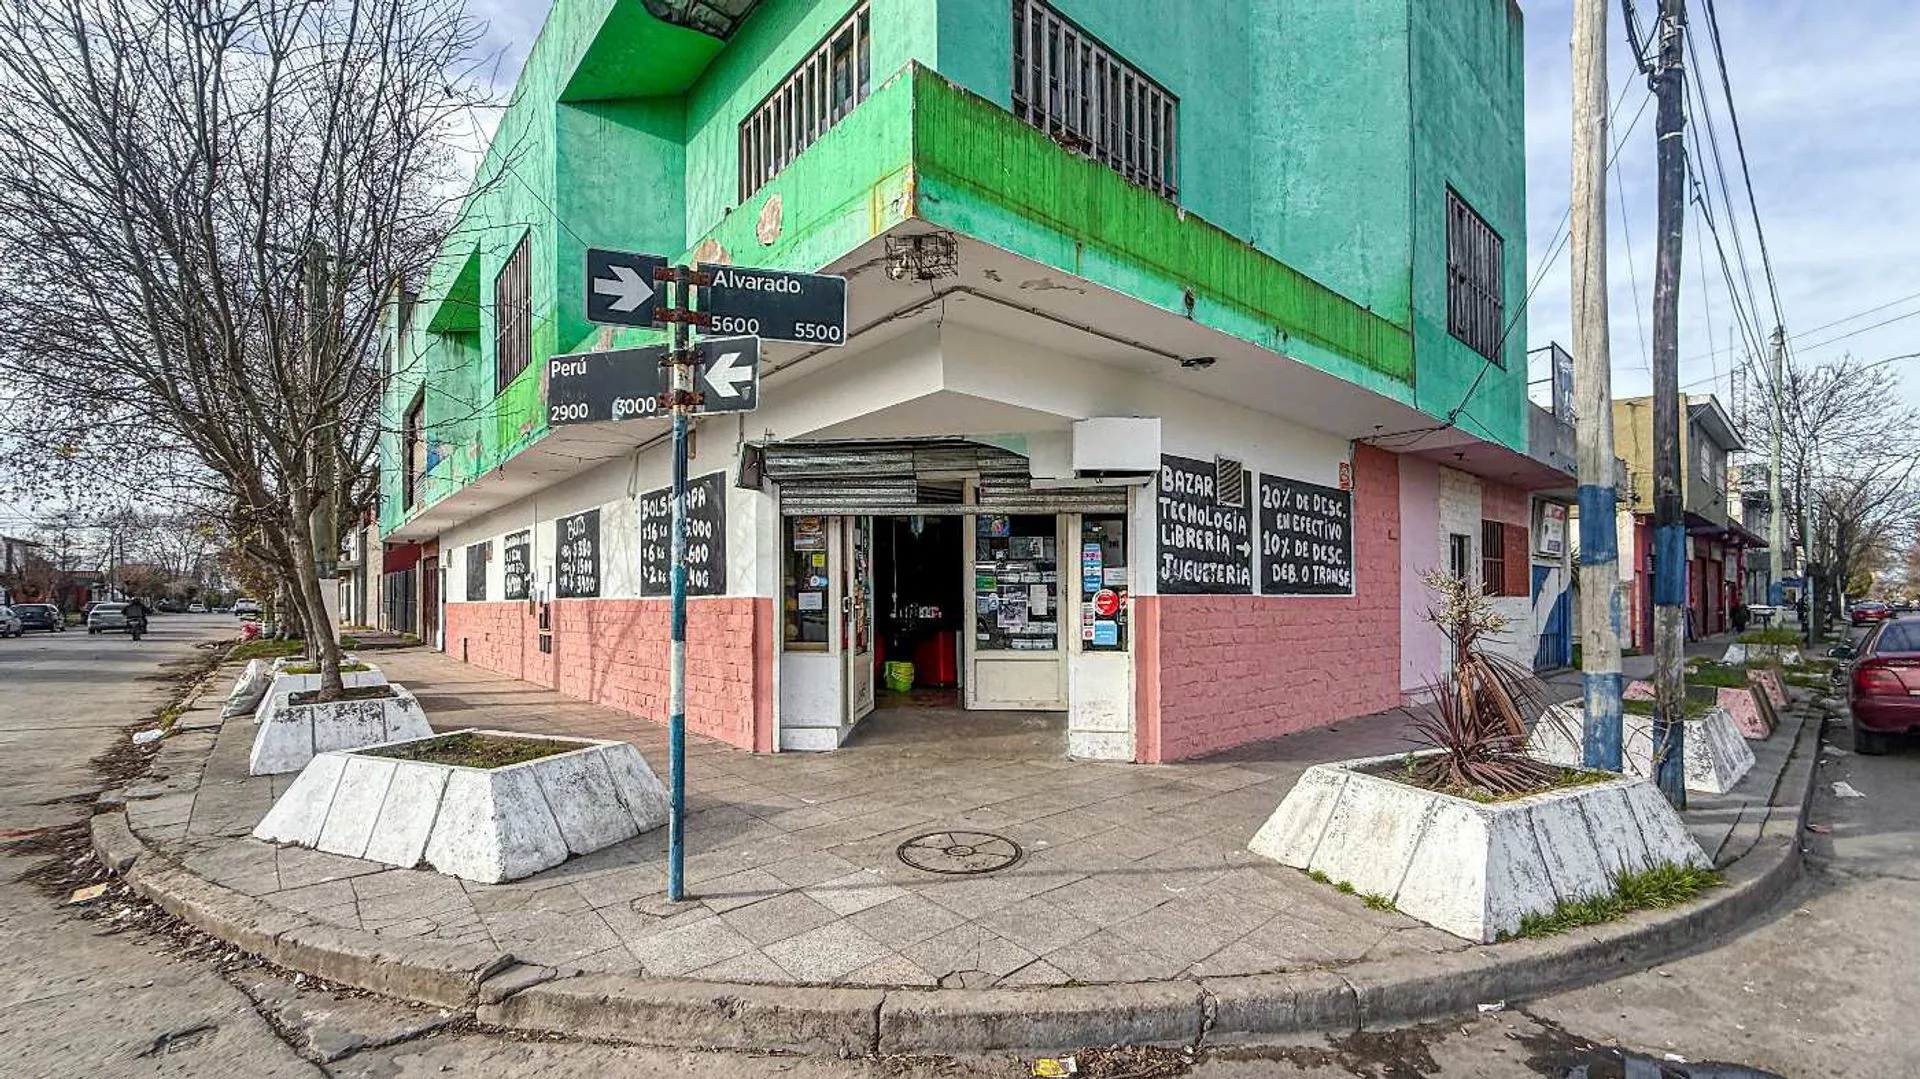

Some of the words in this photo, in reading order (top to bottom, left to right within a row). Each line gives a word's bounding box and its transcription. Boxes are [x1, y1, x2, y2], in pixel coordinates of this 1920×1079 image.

[711, 315, 759, 334] 5600
[794, 322, 840, 341] 5500
[551, 357, 587, 378] Perú
[551, 403, 588, 421] 2900
[617, 397, 657, 416] 3000
[1161, 464, 1214, 497] BAZAR
[1262, 484, 1291, 509] 20%
[1296, 493, 1310, 512] DE
[1276, 513, 1291, 530] EN
[1293, 514, 1342, 541] EFECTIVO
[1263, 530, 1291, 559] 10%
[1295, 539, 1310, 558] DE
[1312, 543, 1347, 565] DESC.
[1272, 562, 1299, 584] DEB.
[1301, 565, 1310, 583] O
